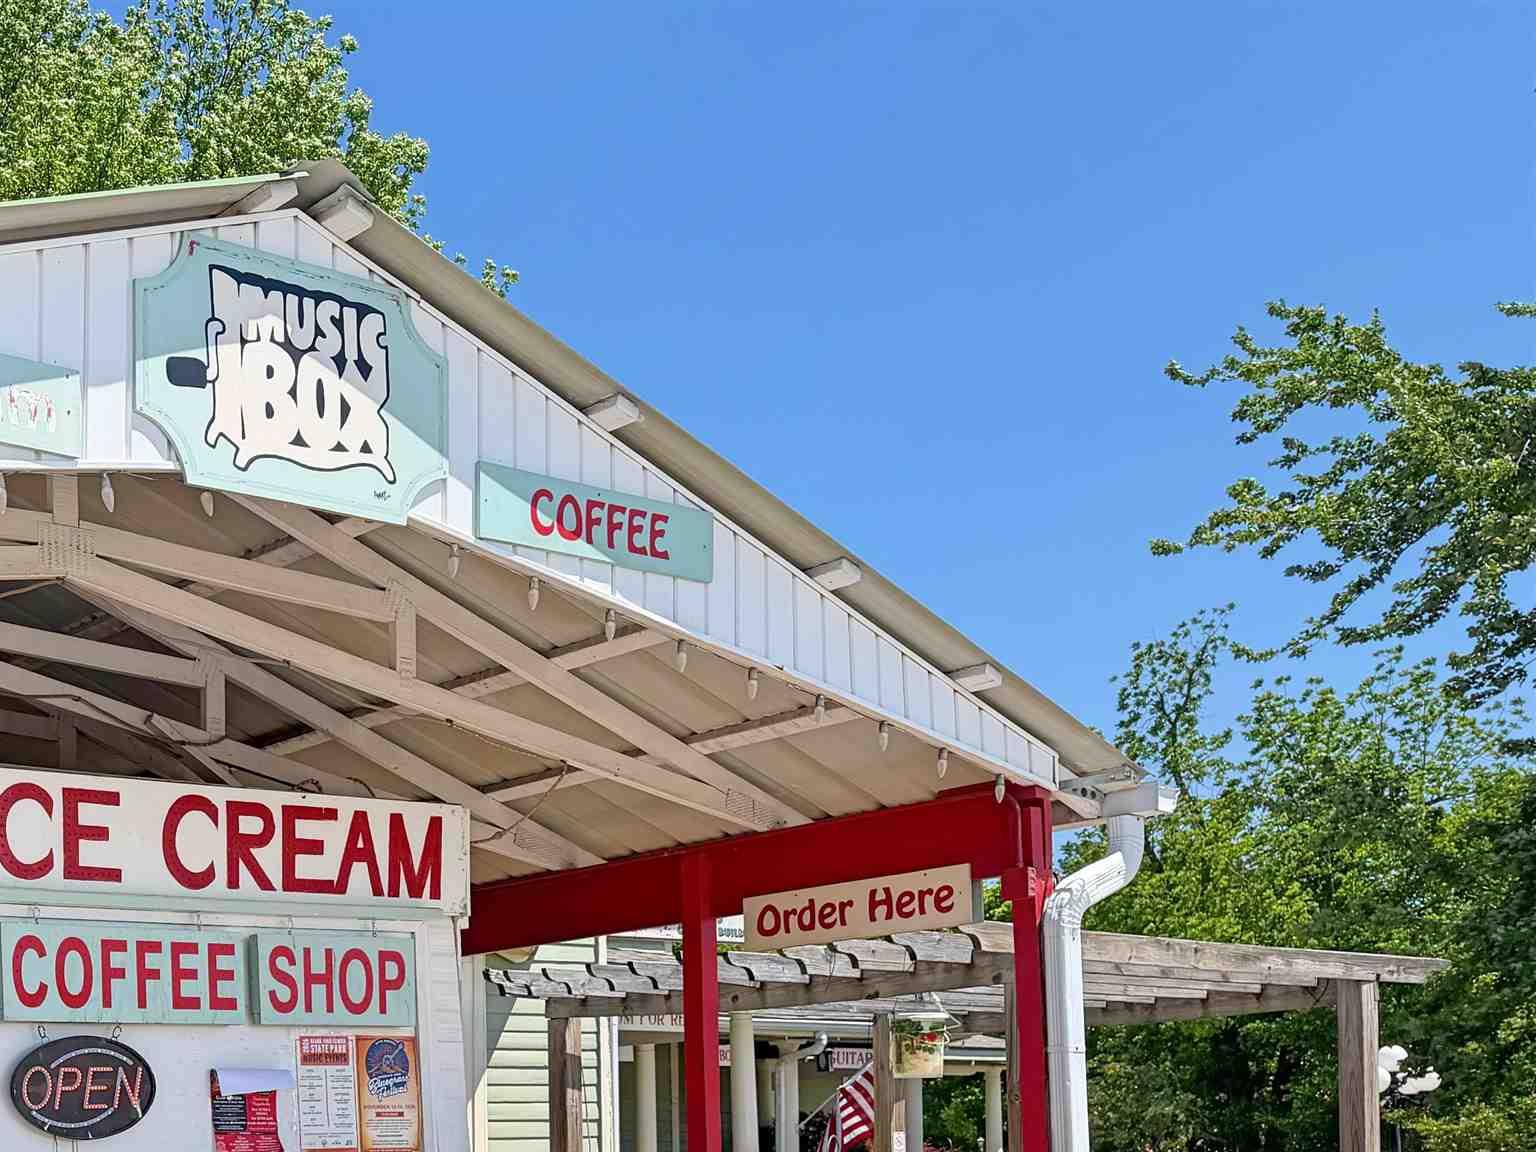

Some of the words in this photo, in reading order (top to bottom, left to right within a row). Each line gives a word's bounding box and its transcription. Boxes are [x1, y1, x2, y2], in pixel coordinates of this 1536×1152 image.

[210, 266, 388, 370] MUSIC
[226, 340, 388, 460] BOX
[530, 488, 672, 561] COFFEE
[161, 793, 444, 901] CREAM
[756, 897, 855, 938] Order
[867, 884, 956, 923] Here
[12, 934, 239, 1012] COFFEE
[267, 945, 407, 1016] SHOP
[22, 1066, 144, 1111] OPEN
